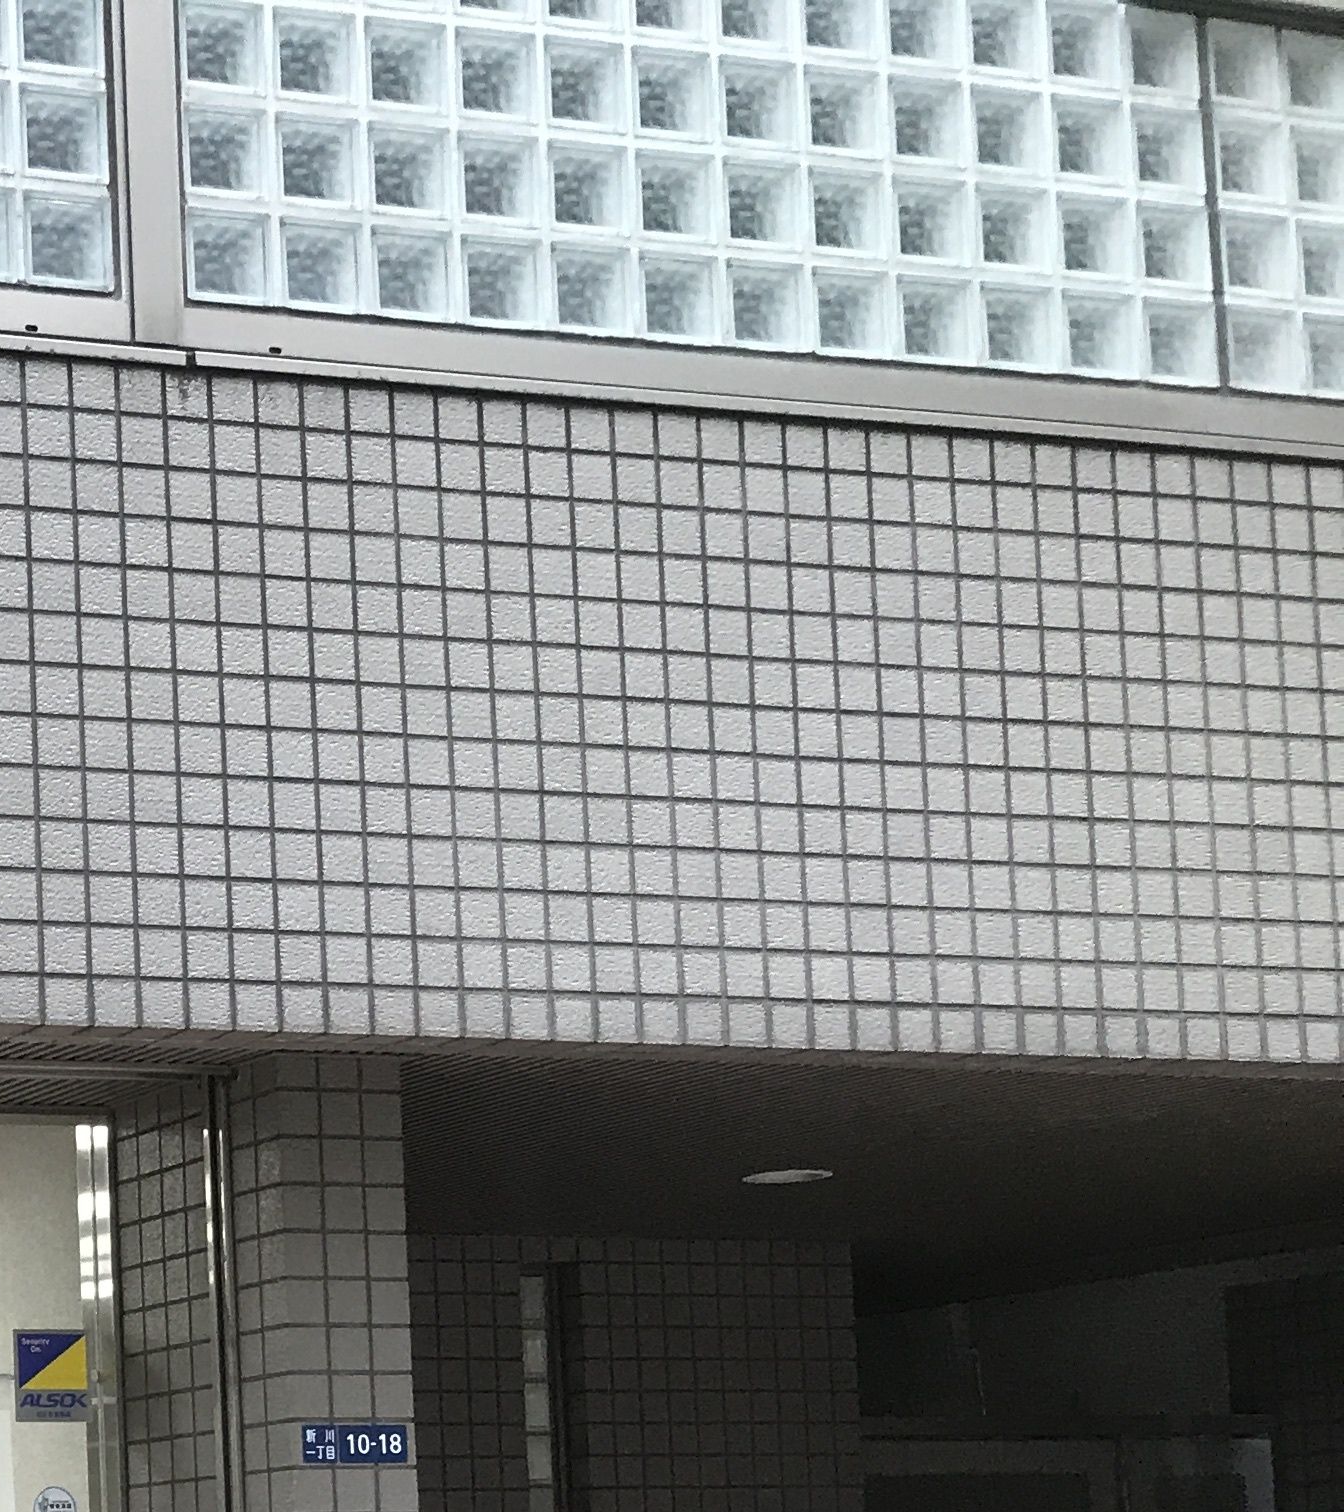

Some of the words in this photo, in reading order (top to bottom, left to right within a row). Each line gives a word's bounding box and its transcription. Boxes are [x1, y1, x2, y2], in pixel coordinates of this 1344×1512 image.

[20, 1393, 87, 1409] ALSOK
[346, 1433, 402, 1455] 10-18
[306, 1446, 335, 1460] 一丁目
